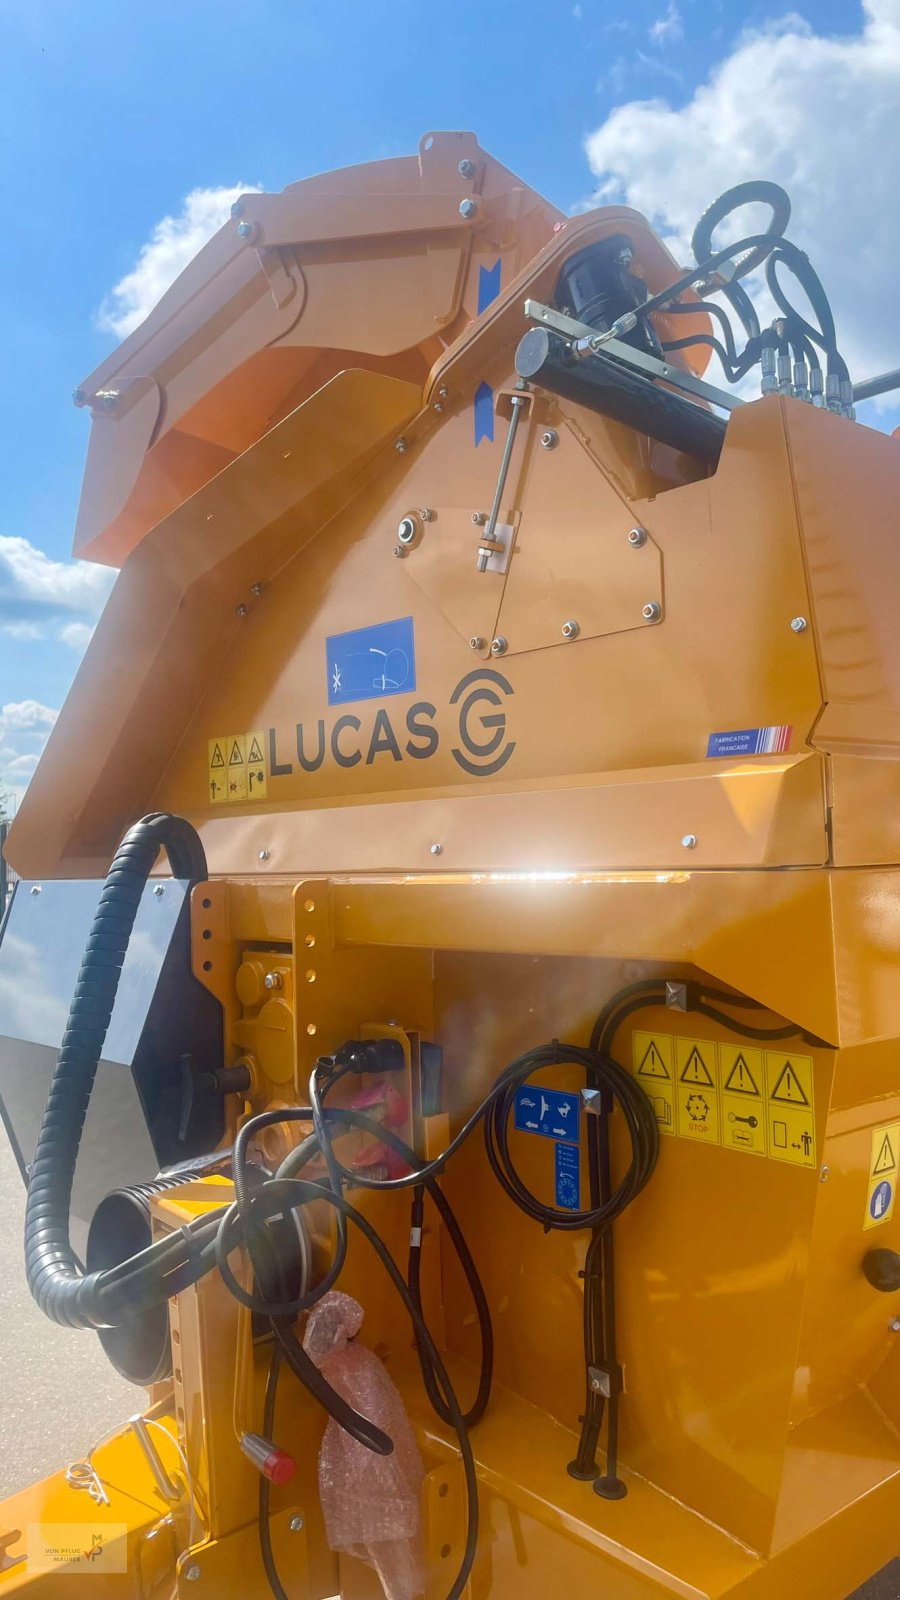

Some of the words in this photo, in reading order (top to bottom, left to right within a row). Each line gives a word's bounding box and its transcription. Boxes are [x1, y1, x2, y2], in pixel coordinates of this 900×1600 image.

[269, 702, 439, 776] LUCAS
[714, 735, 750, 743] FABRICATION
[688, 1123, 709, 1133] STOP
